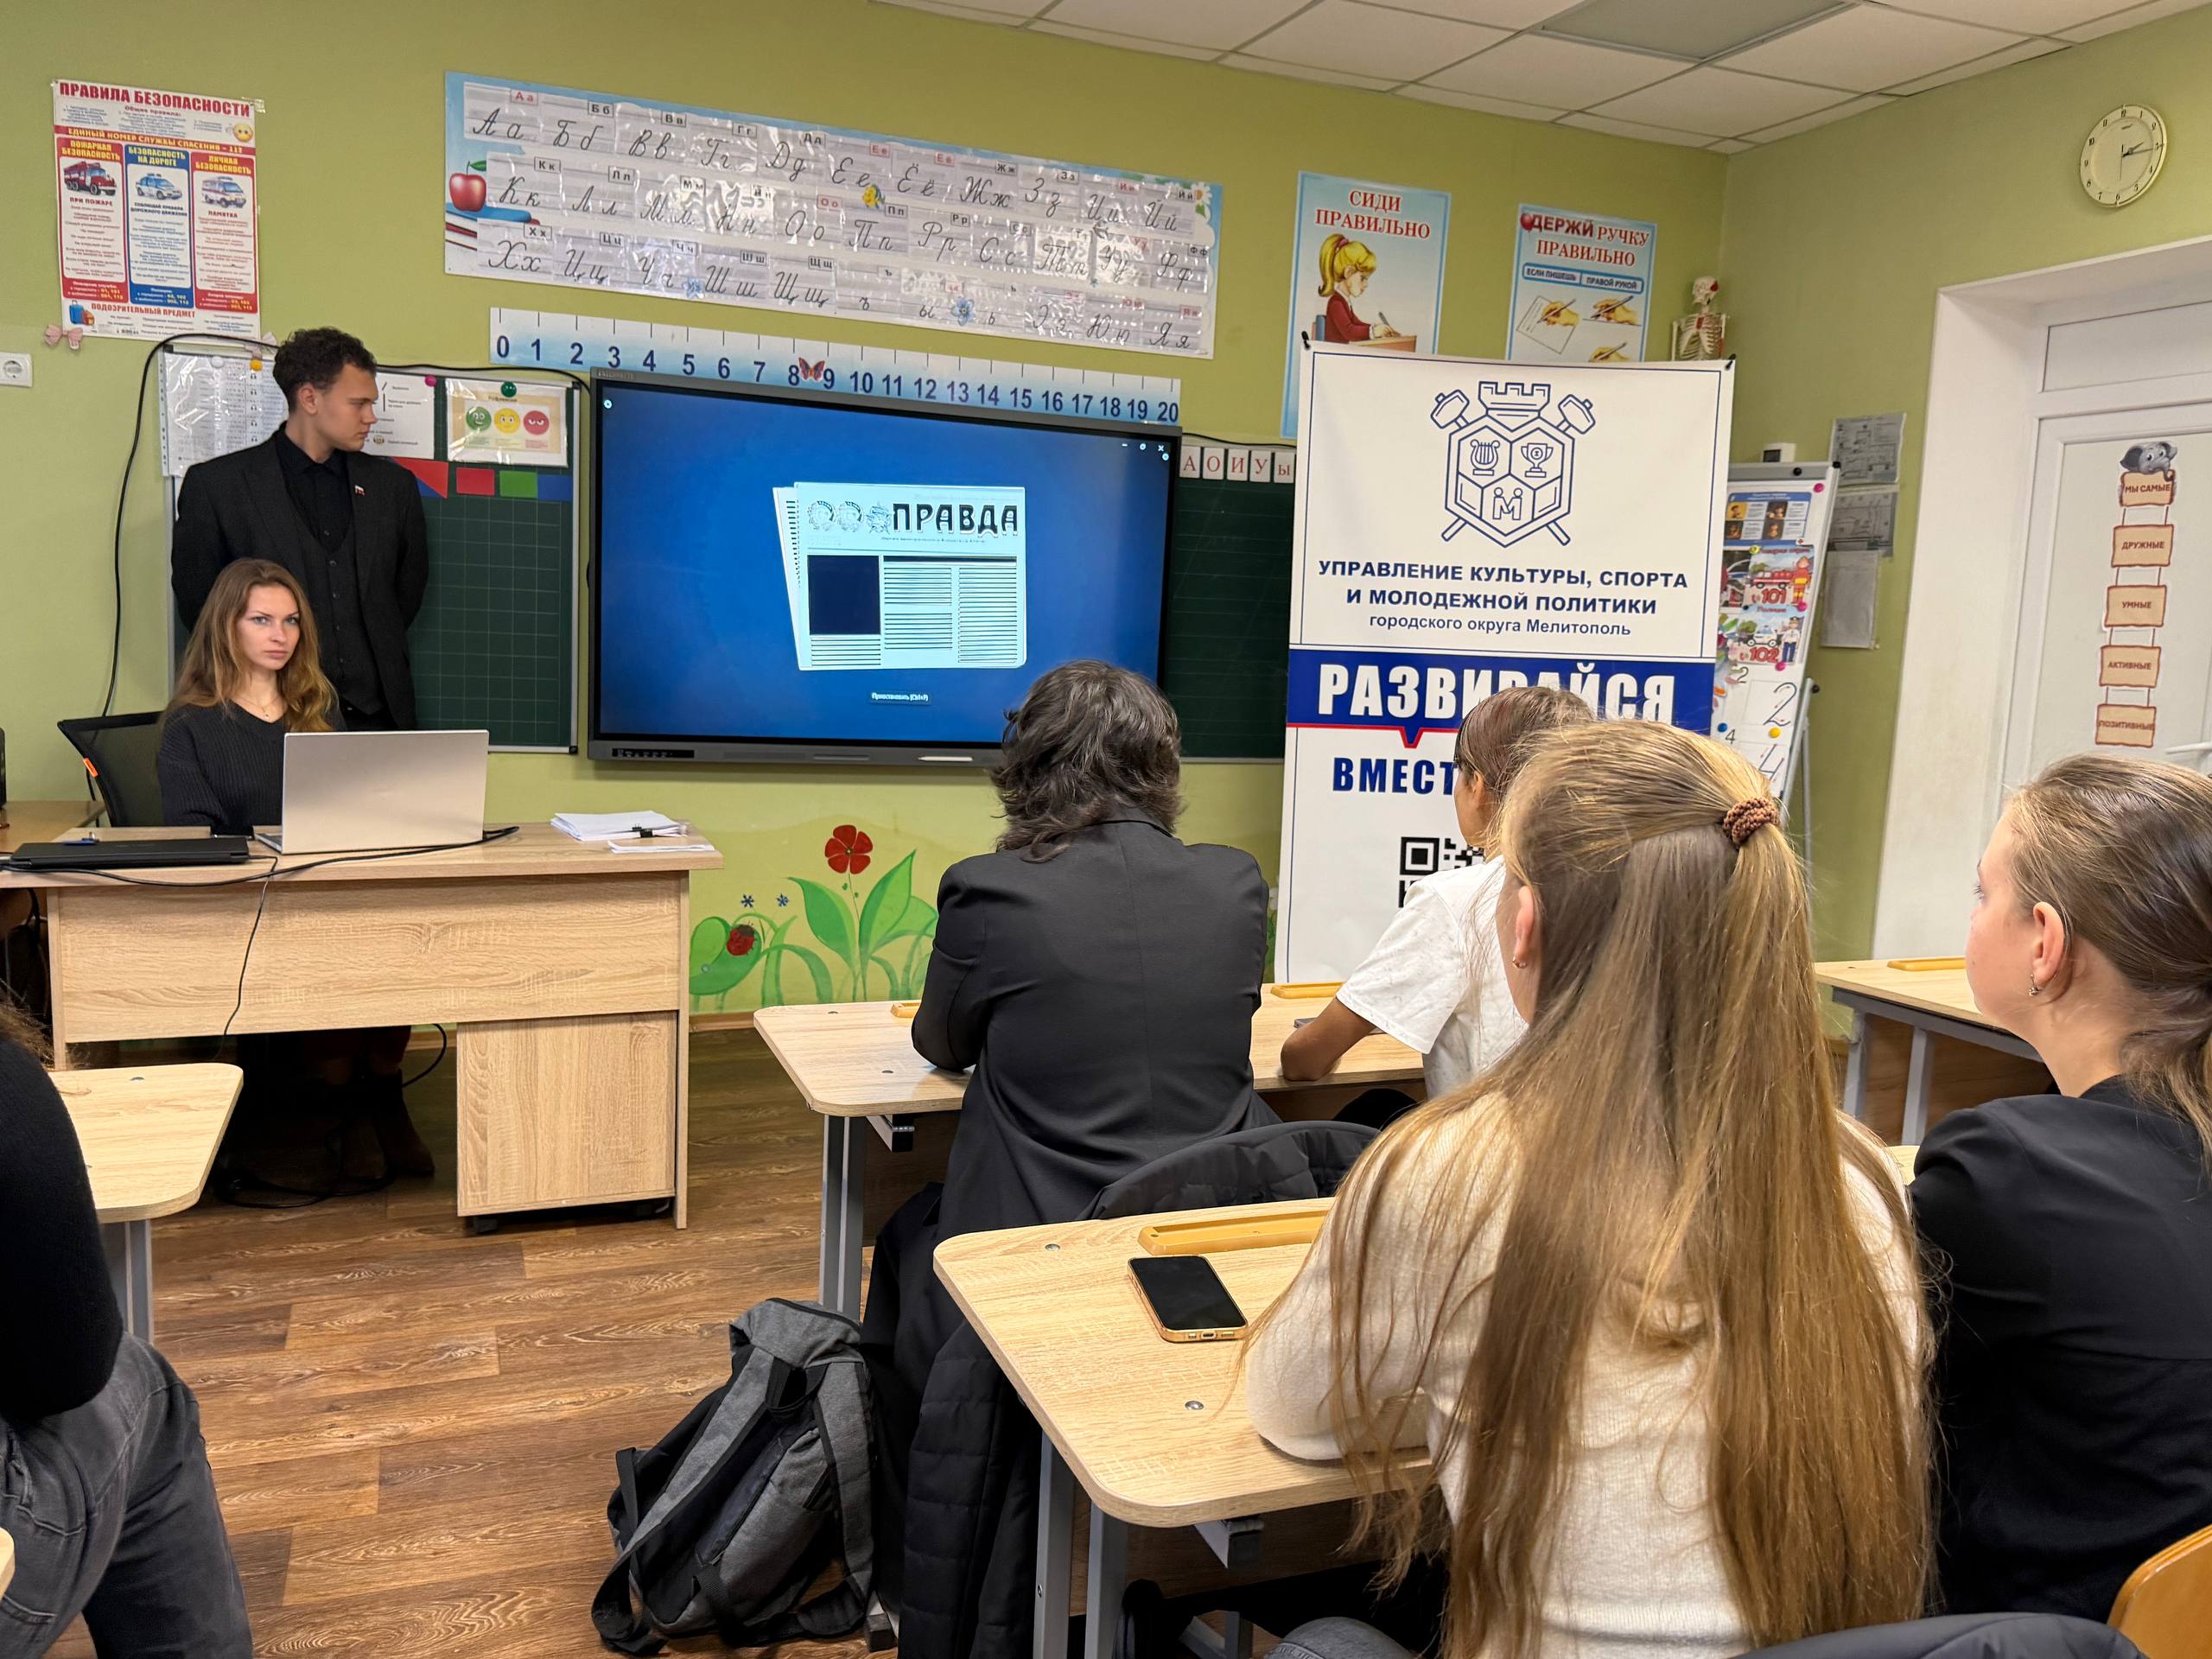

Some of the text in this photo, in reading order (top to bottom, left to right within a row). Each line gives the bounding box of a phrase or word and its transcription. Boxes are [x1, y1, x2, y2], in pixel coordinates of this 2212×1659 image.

[60, 81, 130, 103] ПРАВИЛА
[134, 90, 250, 117] БЕЗОПАСНОСТИ
[68, 127, 105, 139] ЕДИНЫЙ
[107, 130, 137, 142] НОМЕР
[138, 135, 175, 147] СЛУЖБЫ
[61, 147, 121, 162] БЕЗОПАСНОСТЬ
[137, 156, 177, 167] НА ДОРОГЕ
[1349, 189, 1402, 213] СИДИ
[1315, 208, 1431, 239] ПРАВИЛЬНО
[1597, 226, 1650, 247] РУЧКУ
[1536, 239, 1636, 267] ПРАВИЛЬНО
[1526, 268, 1577, 282] ЕСЛИ ПИШЕШЬ
[1586, 276, 1637, 290] ПРАВОЙ РУКОЙ
[496, 335, 1179, 423] 0 1 2 3 4 5 6 7 8 9 10 11 12 13 14 15 16 17 18 19 20
[1183, 455, 1197, 472] А
[1206, 455, 1220, 473] О
[1231, 457, 1244, 474] И
[1255, 459, 1268, 474] У
[2125, 483, 2171, 493] МЫ САМЫЕ
[892, 503, 1019, 537] ПРАВДА
[2121, 541, 2164, 550] ДРУЖНЫЕ
[1319, 560, 1688, 588] УПРАВЛЕНИЕ КУЛЬТУРЫ, СПОРТА
[1345, 588, 1657, 615] И МОЛОДЕЖНОЙ ПОЛИТИКИ
[2121, 601, 2152, 610] УМНЫЕ
[1369, 614, 1631, 637] городского округа Мелитополь
[2107, 661, 2152, 671] АКТИВНЫЕ
[1763, 682, 1797, 727] 2
[2098, 721, 2155, 731] ПОЗИТИВНЫЕ
[1332, 757, 1459, 796] ВМЕСТ
